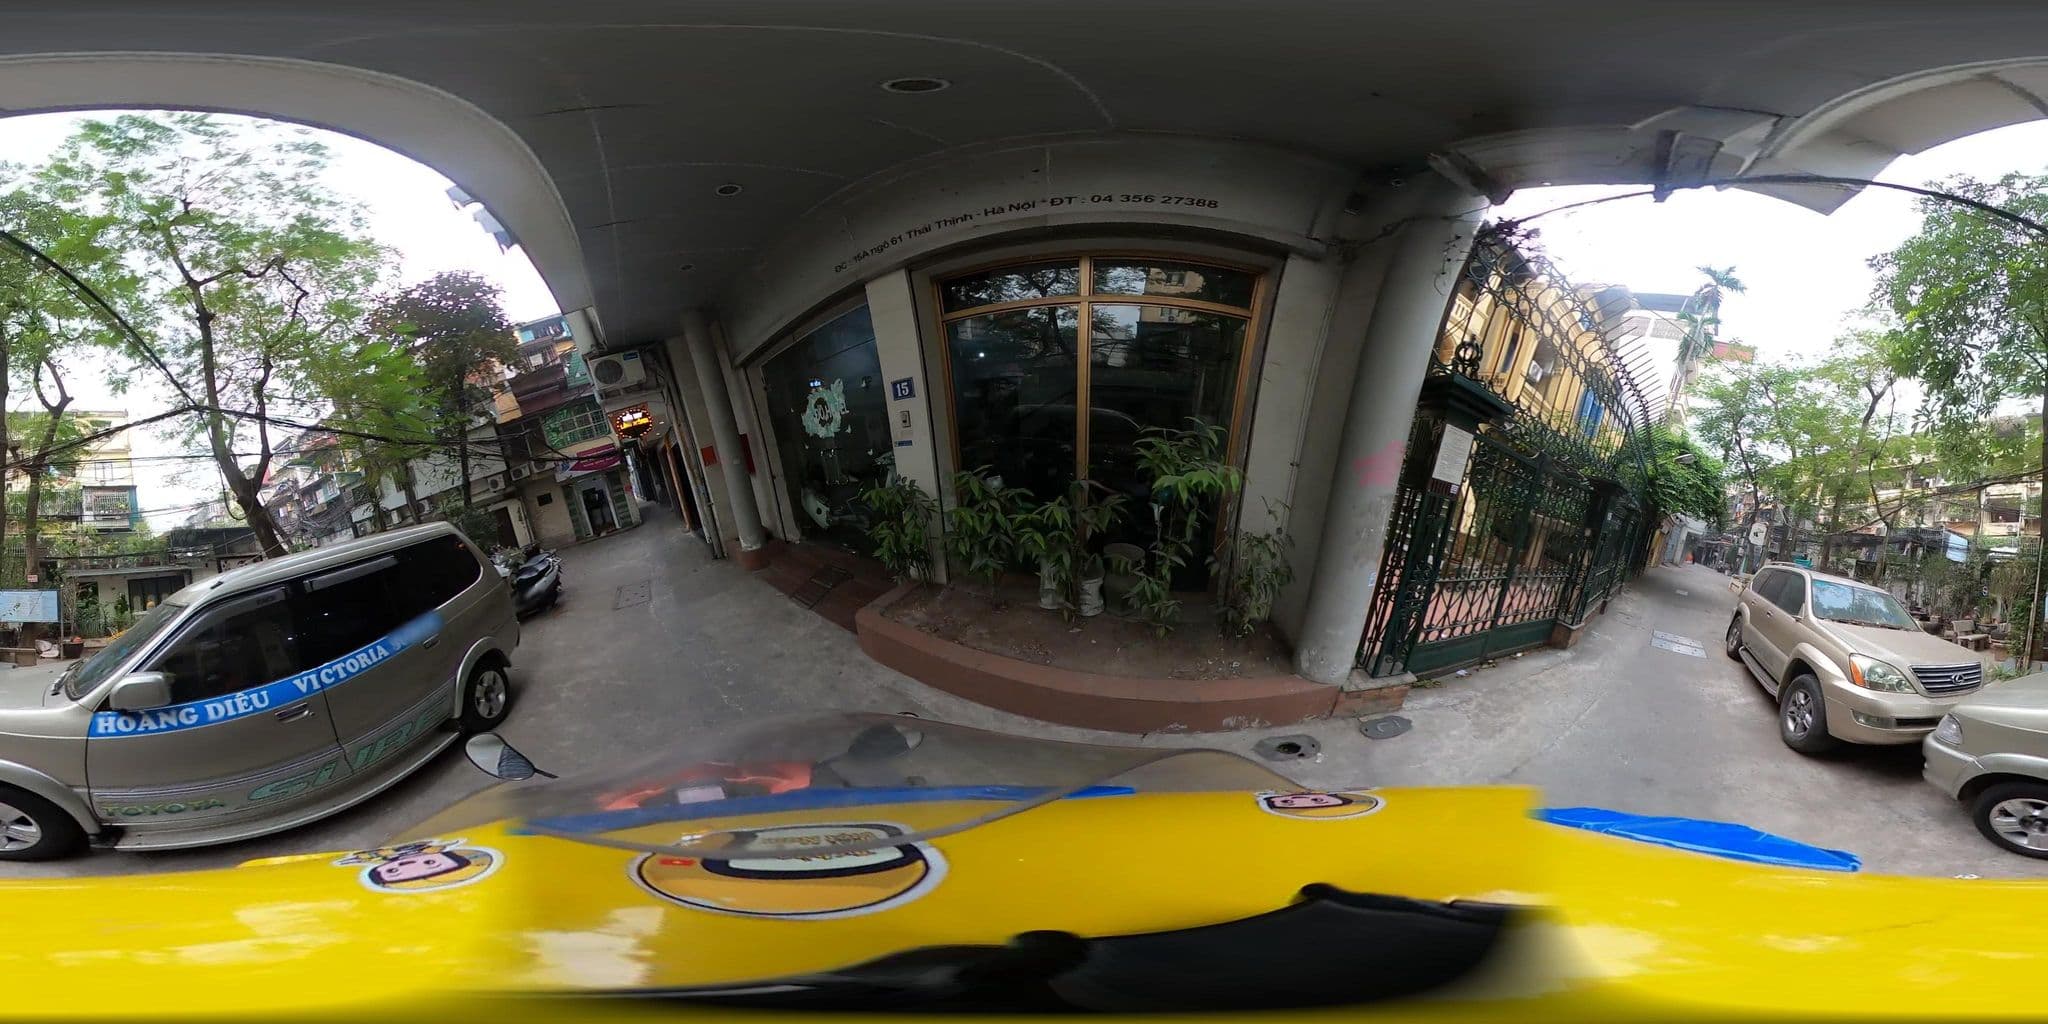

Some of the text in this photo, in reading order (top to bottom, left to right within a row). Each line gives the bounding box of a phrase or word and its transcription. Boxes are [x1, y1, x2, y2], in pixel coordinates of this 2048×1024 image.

[890, 234, 904, 245] 61
[984, 206, 1005, 216] Hà
[1008, 200, 1036, 212] Nội
[1050, 196, 1078, 206] ĐT
[1091, 194, 1113, 203] 04
[1120, 194, 1156, 203] 356
[1161, 195, 1219, 209] 27388
[896, 382, 909, 397] 15
[292, 644, 390, 694] VICTORIA
[102, 799, 225, 817] TOYOTA
